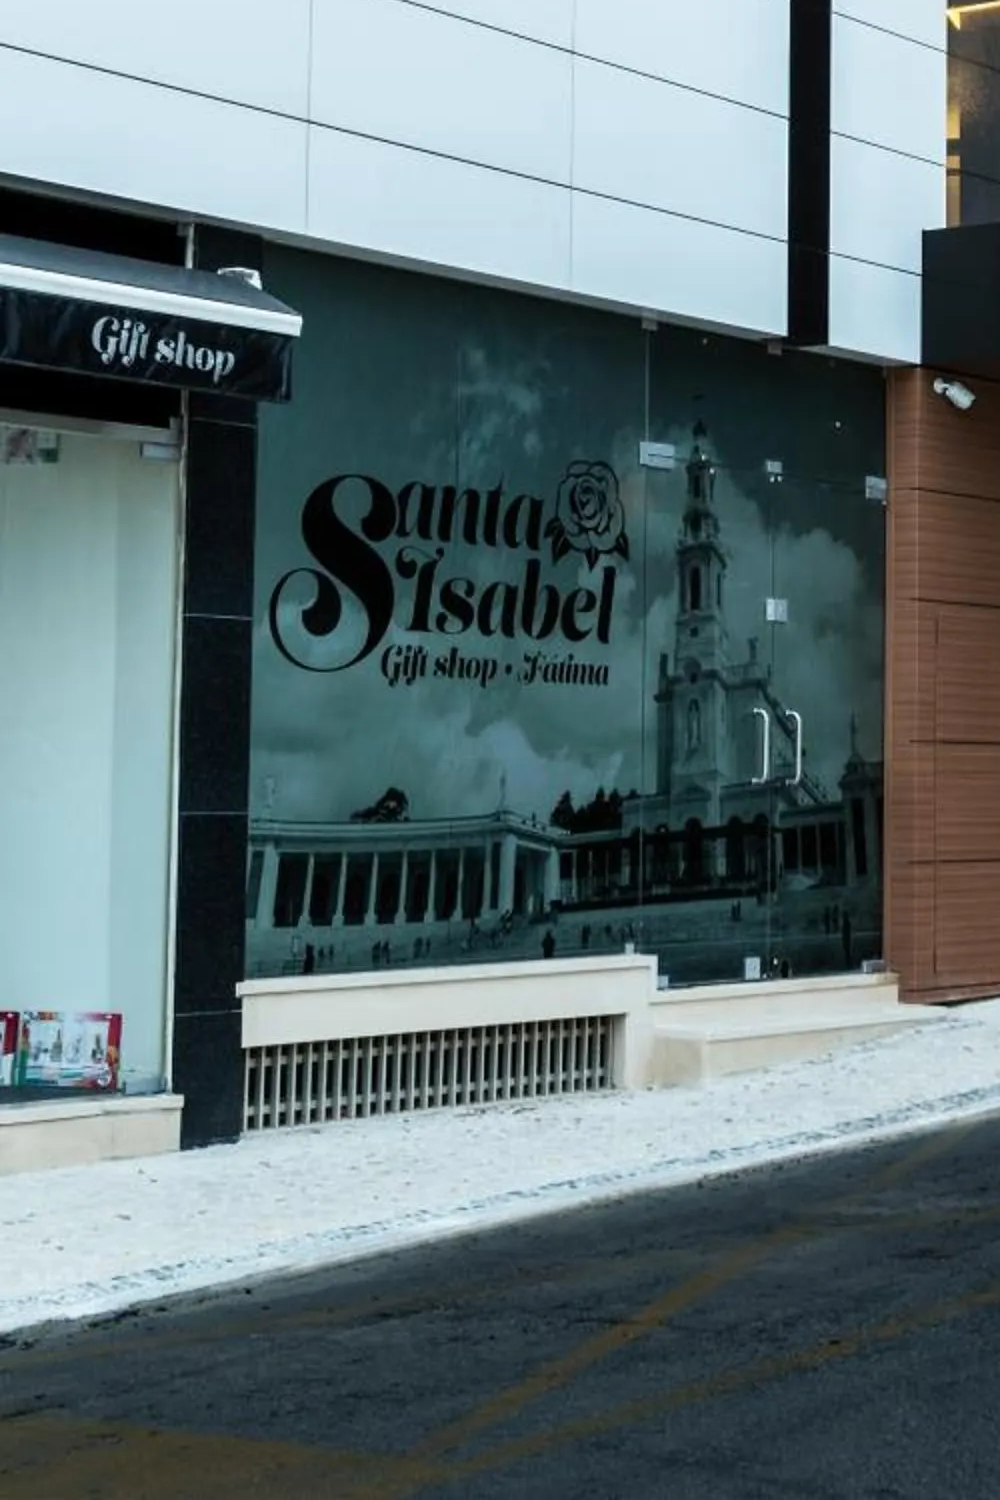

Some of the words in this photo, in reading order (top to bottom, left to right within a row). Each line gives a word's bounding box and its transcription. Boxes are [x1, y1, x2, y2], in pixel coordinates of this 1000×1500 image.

[92, 316, 150, 366] Gift
[154, 331, 235, 384] shop
[269, 474, 548, 672] Santa
[395, 547, 616, 644] Isabel
[380, 643, 427, 687] Gift
[433, 647, 497, 688] shop
